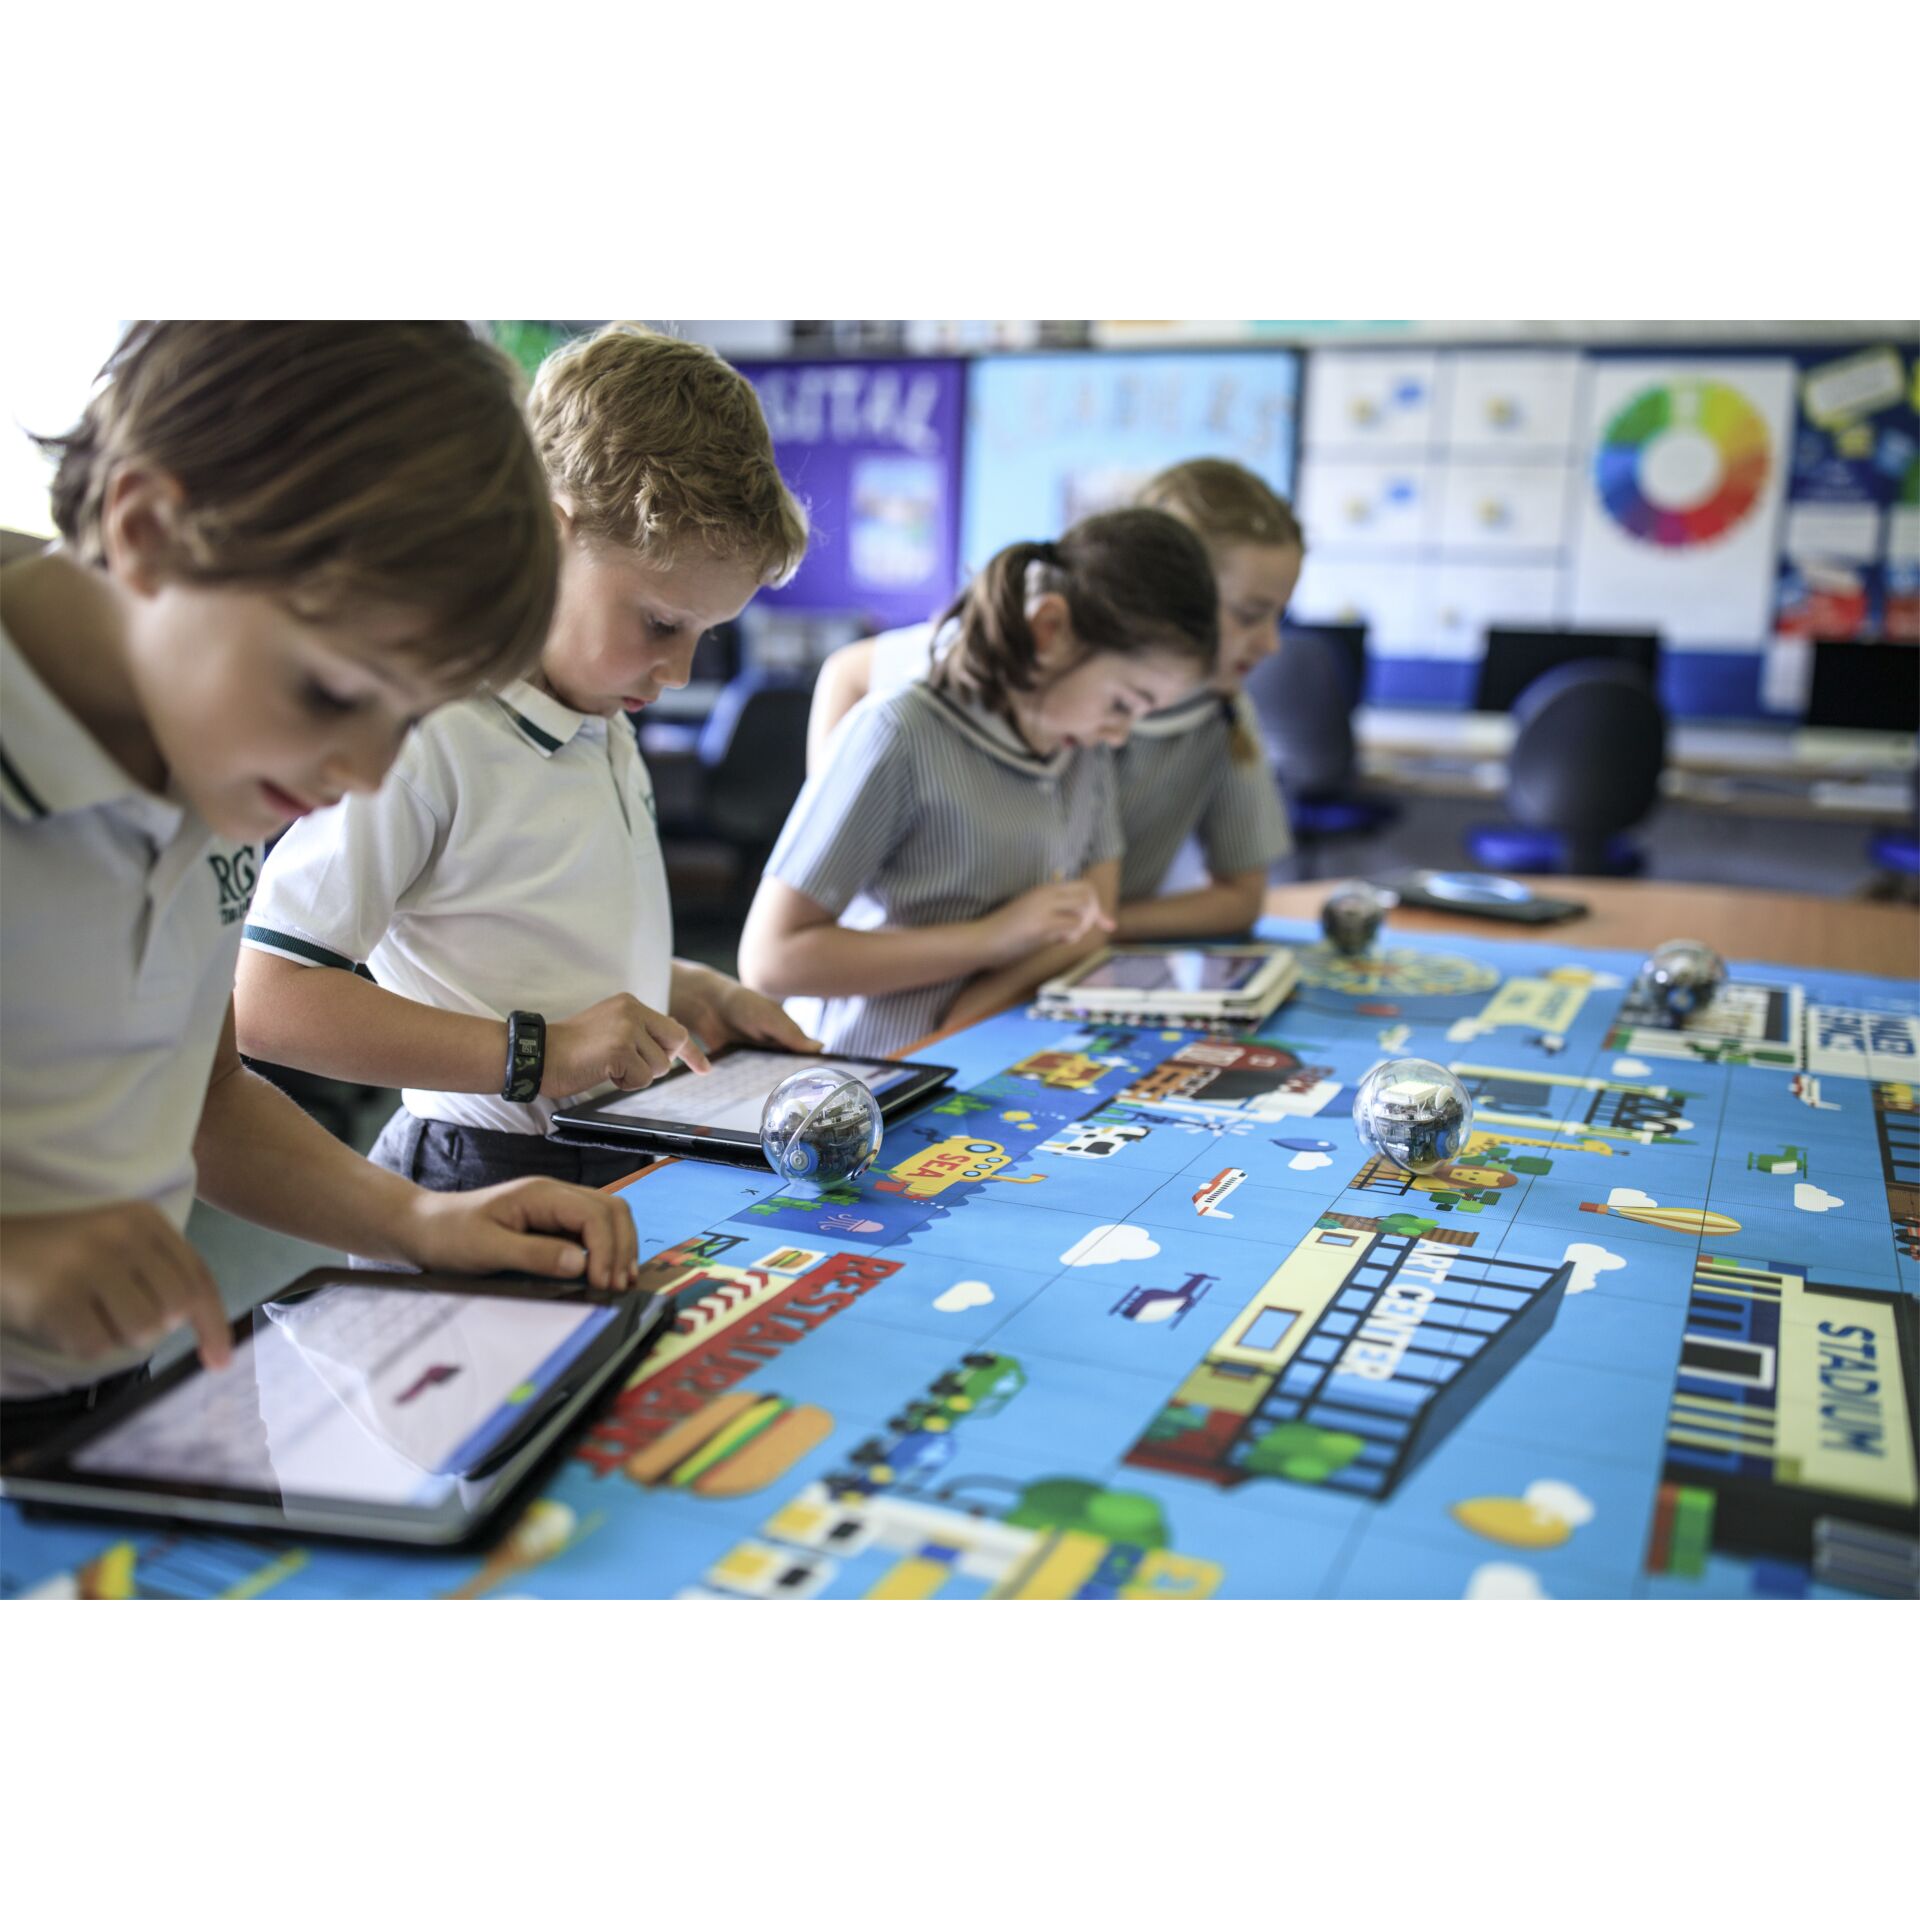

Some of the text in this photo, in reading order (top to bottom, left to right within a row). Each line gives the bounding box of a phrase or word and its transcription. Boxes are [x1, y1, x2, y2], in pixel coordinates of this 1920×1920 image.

[905, 1153, 971, 1178] SEA
[577, 1253, 905, 1477] RESTAURANT
[1333, 1237, 1460, 1381] ART CENTER
[1817, 1321, 1886, 1459] STADIUM
